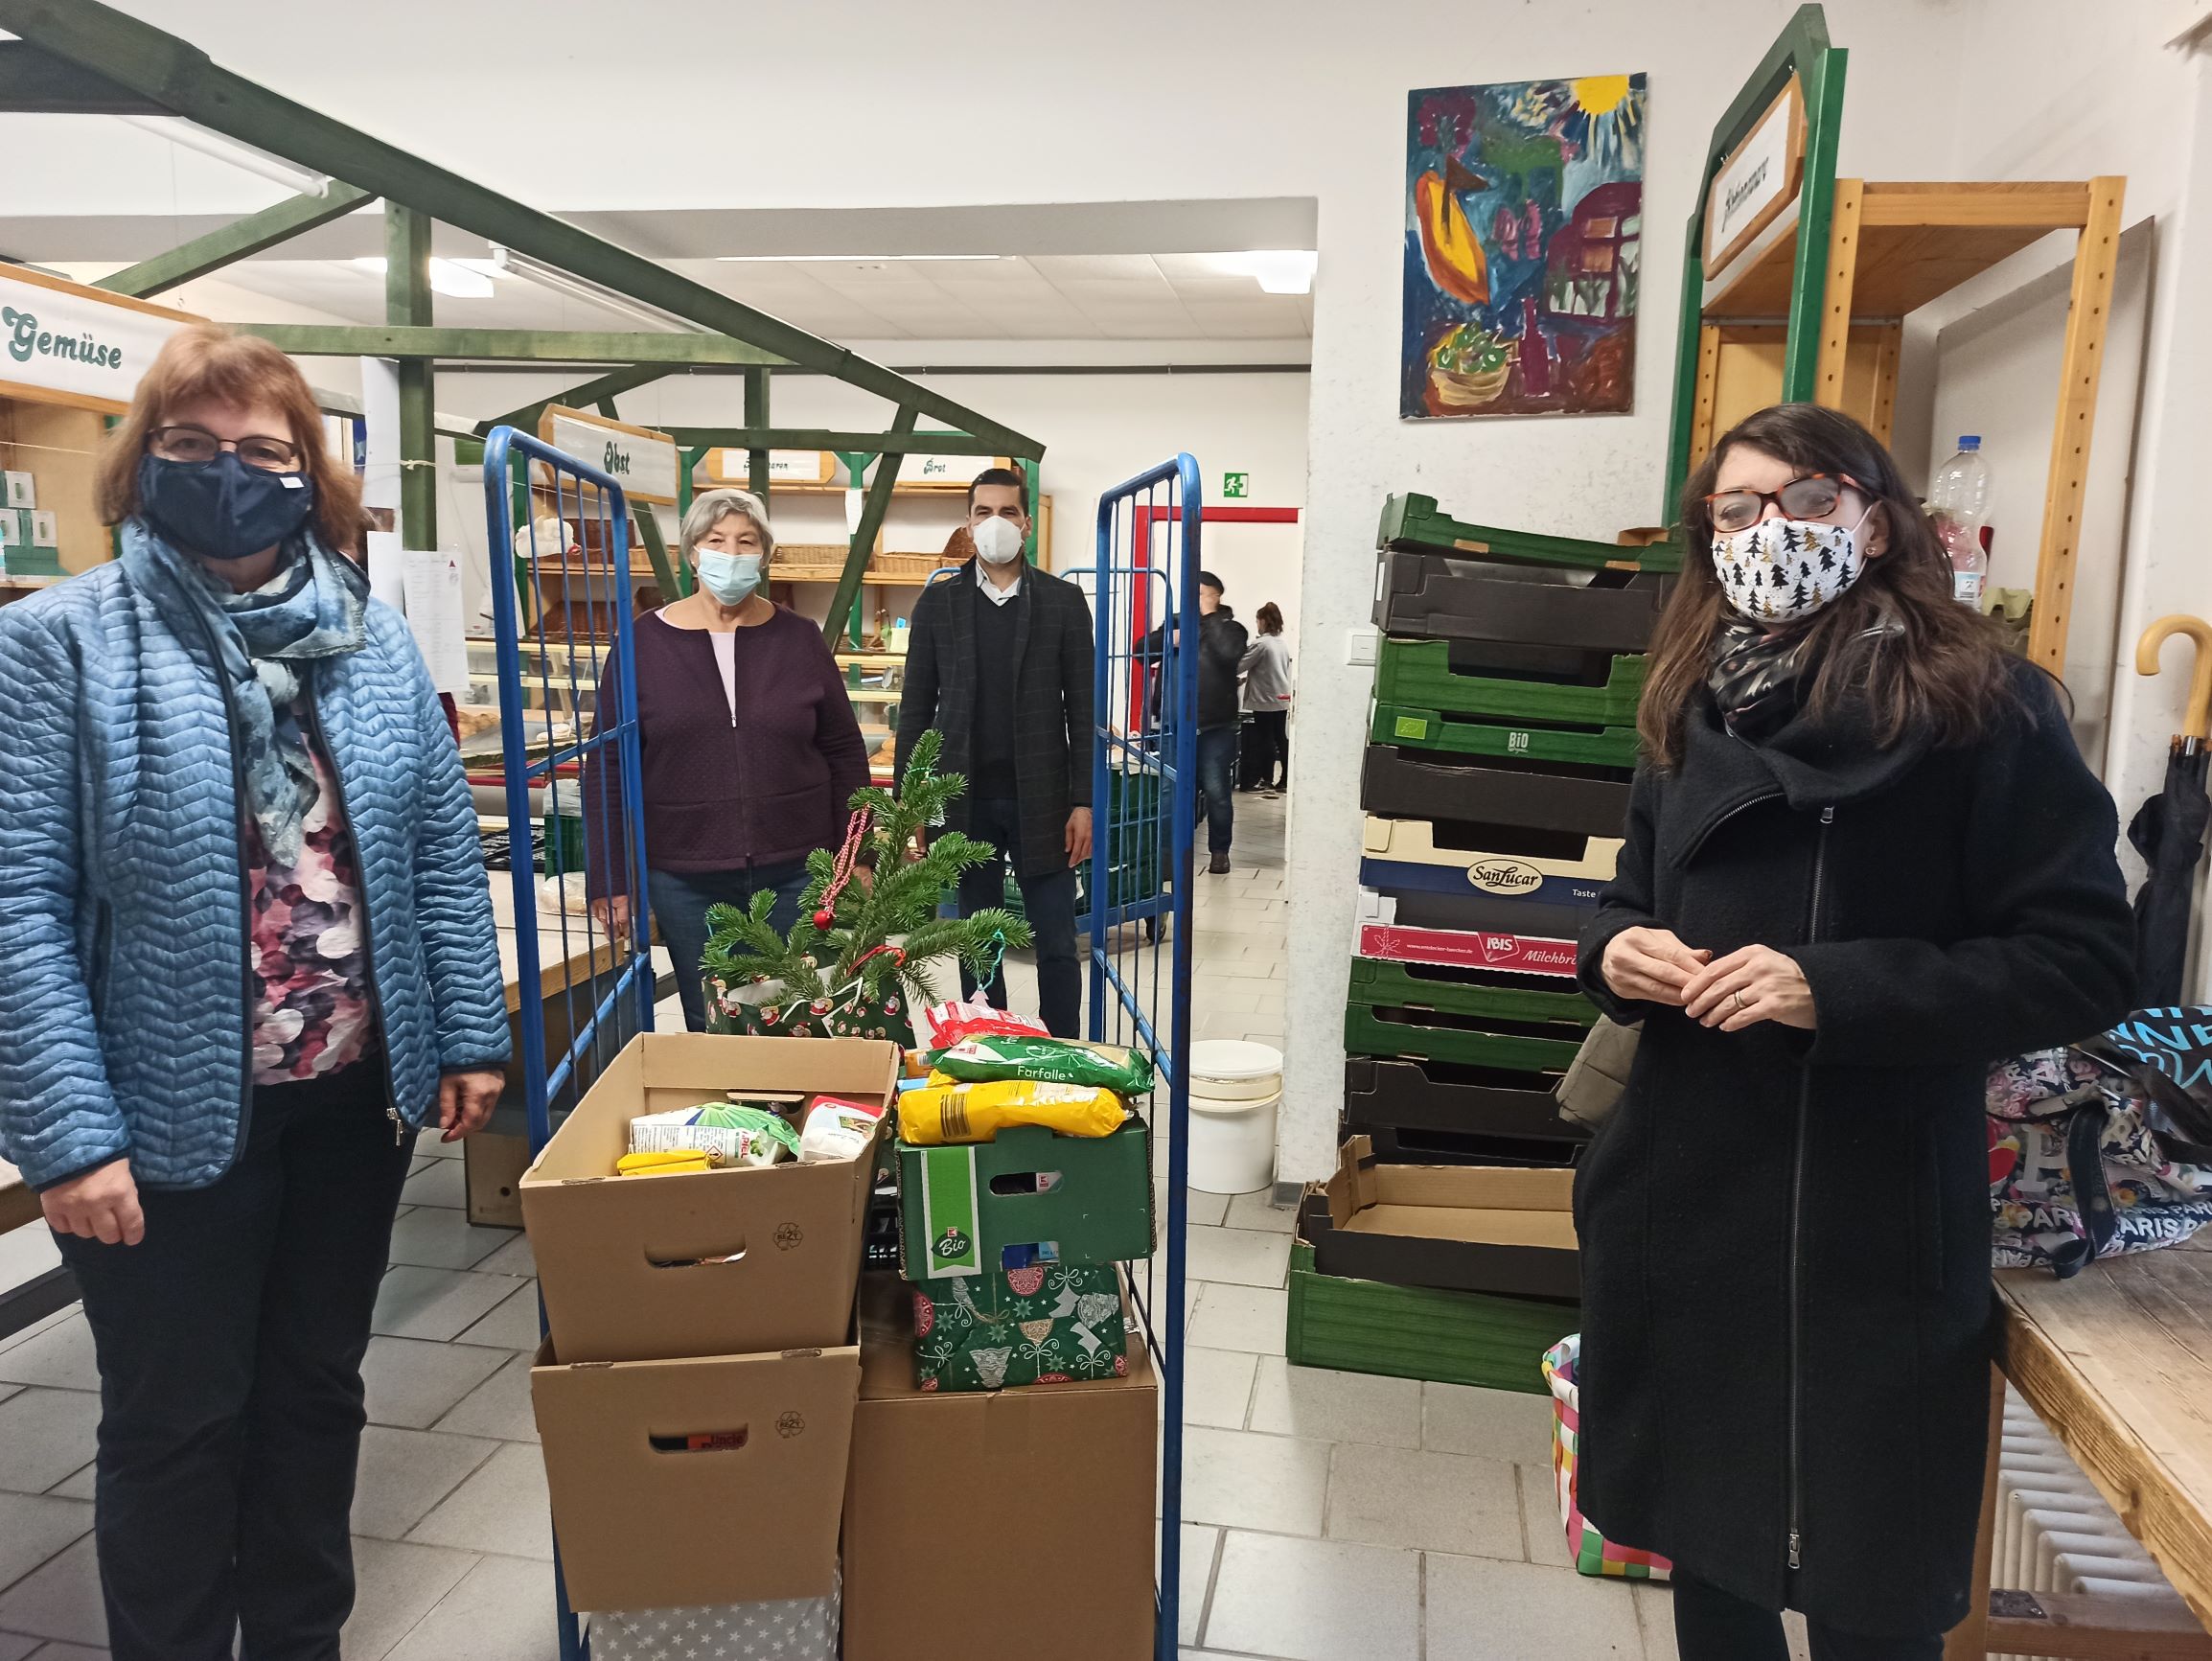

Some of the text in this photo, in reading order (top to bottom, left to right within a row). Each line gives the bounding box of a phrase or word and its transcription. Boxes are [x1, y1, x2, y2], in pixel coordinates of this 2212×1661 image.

[1, 306, 122, 369] Gemüse
[604, 441, 630, 474] Obst
[1472, 865, 1538, 888] SanLucar
[1572, 888, 1597, 898] Taste
[1486, 937, 1513, 951] IBIS
[1017, 1065, 1067, 1081] Farfalle
[939, 1238, 966, 1256] Bio
